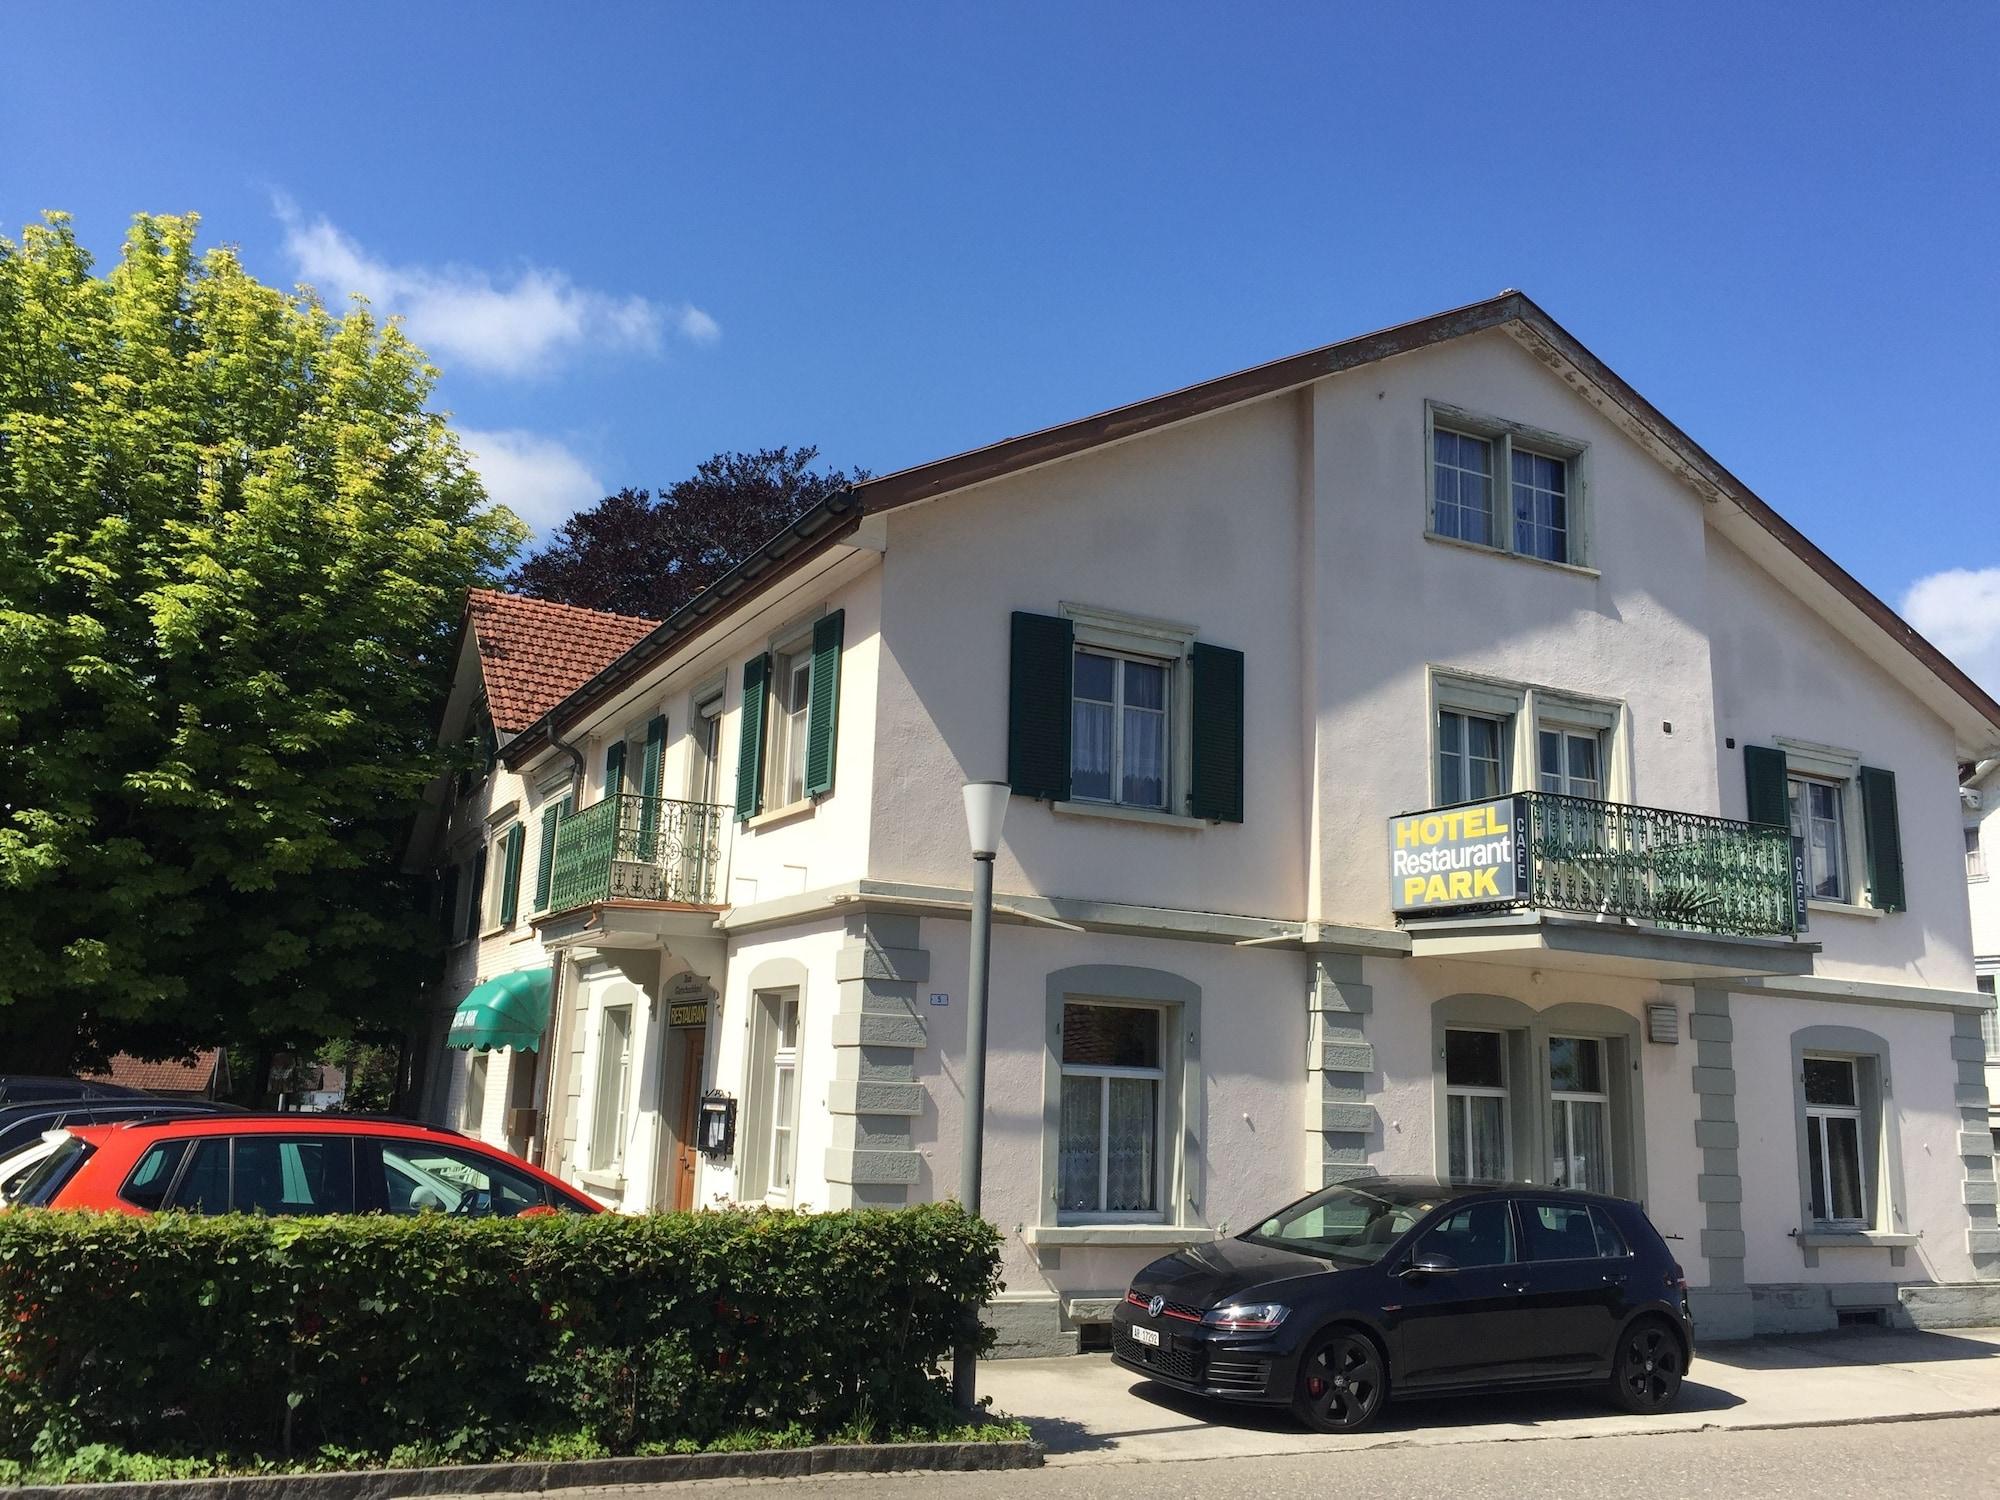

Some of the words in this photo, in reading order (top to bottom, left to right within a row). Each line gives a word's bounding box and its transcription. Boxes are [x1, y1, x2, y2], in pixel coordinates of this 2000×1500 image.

[1396, 806, 1509, 849] HOTEL
[1516, 817, 1527, 879] CAFE
[1393, 835, 1512, 877] Restaurant
[1404, 866, 1501, 905] PARK
[1795, 856, 1805, 913] CAFE
